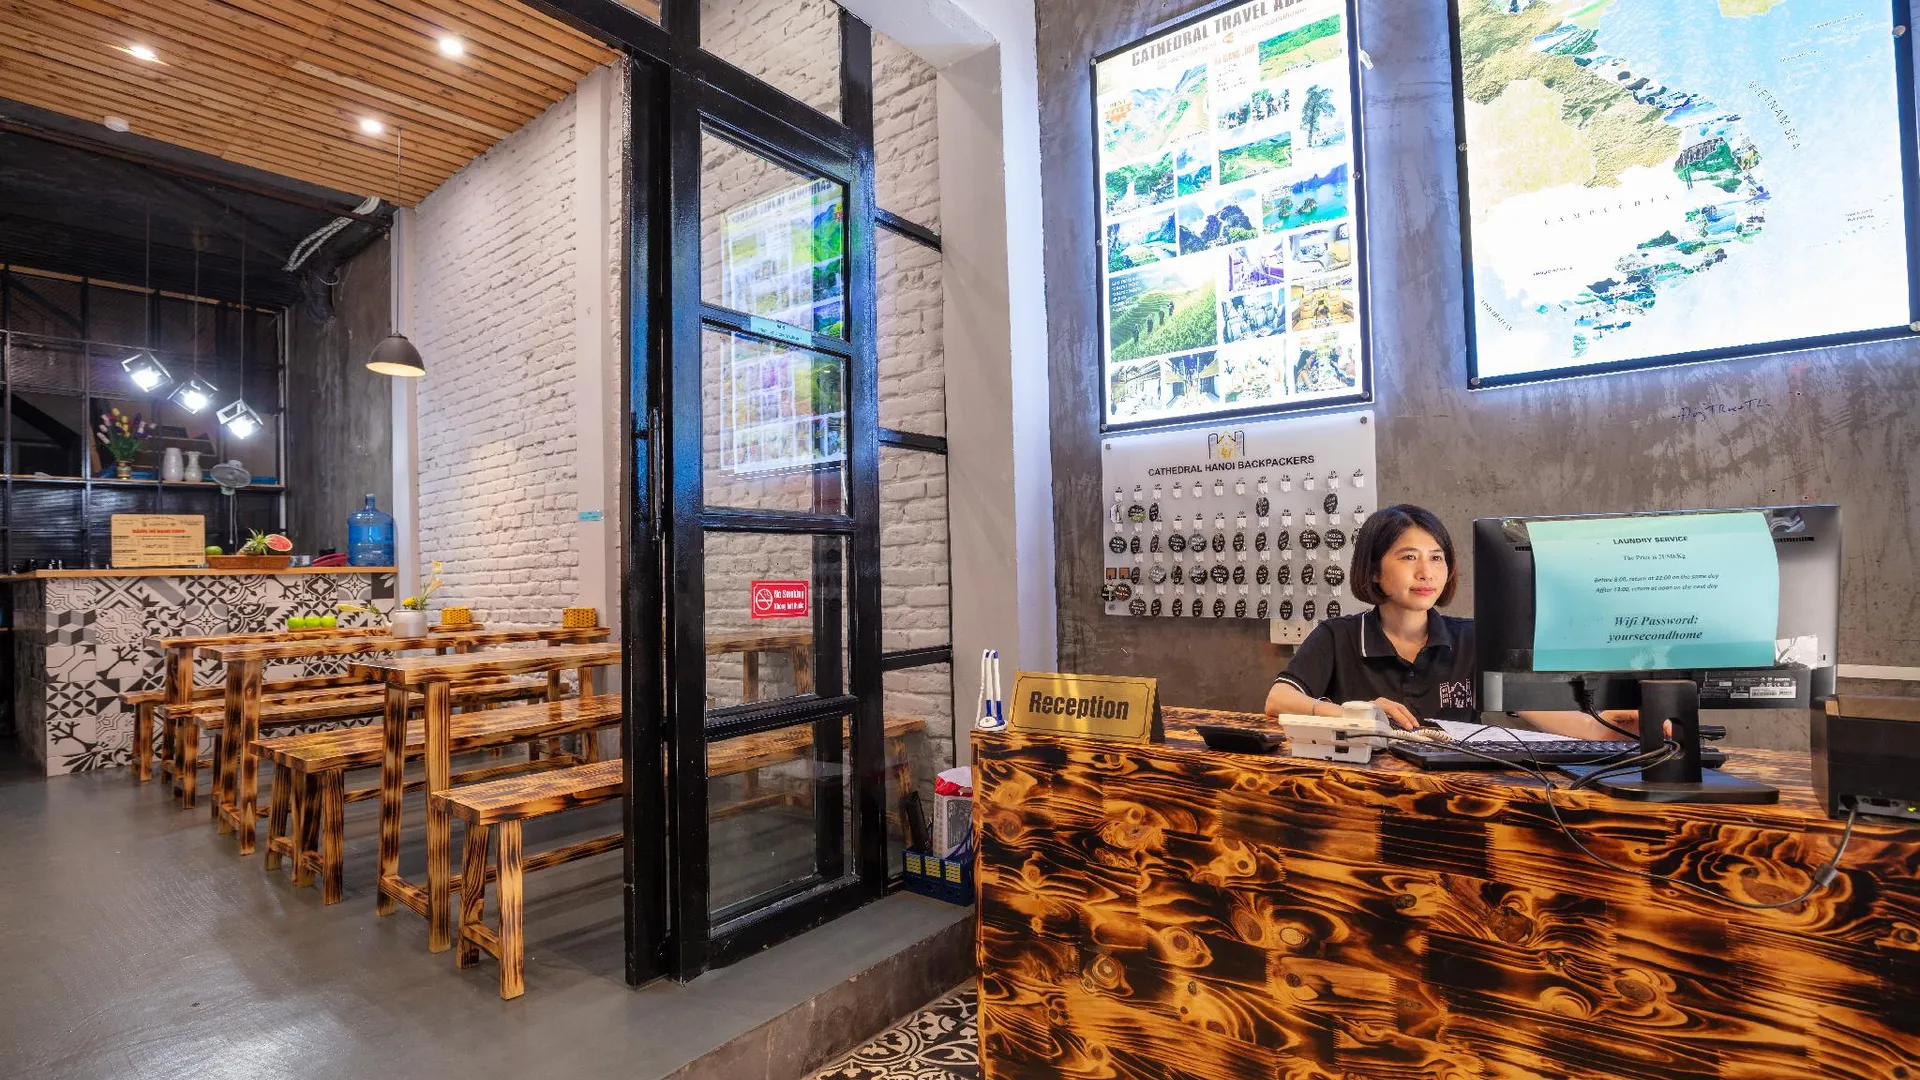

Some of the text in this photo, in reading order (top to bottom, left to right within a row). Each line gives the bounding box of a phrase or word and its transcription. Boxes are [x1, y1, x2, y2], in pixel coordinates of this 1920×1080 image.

[1132, 26, 1210, 67] CATHEDRAL
[1214, 2, 1268, 34] TRAVEL
[1148, 455, 1315, 477] CATHEDRAL HANOI BACKPACKERS
[1612, 535, 1689, 545] LAUNDRY SERVICE
[1707, 572, 1720, 580] day
[773, 589, 804, 599] No Smoking
[1614, 615, 1699, 628] Wifi Password:
[1606, 630, 1703, 644] yoursecondhome
[1028, 690, 1130, 721] Reception
